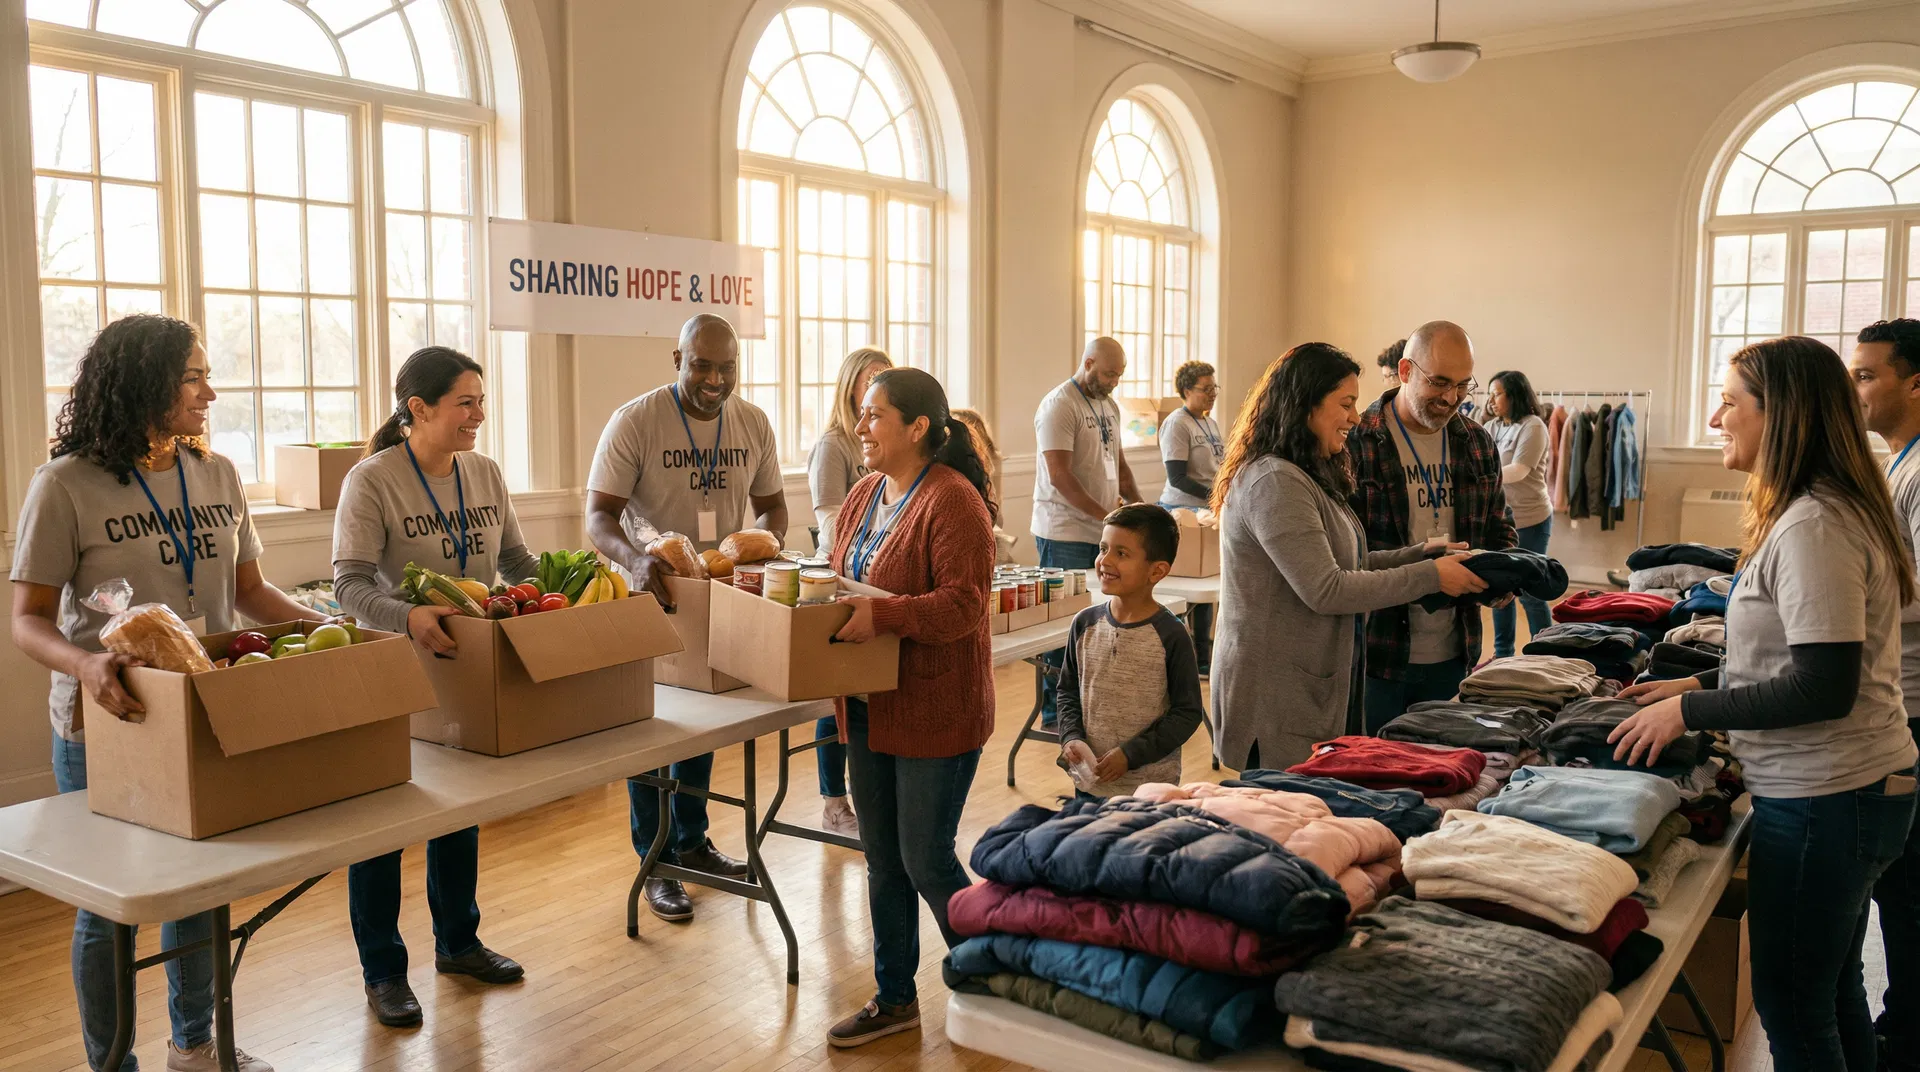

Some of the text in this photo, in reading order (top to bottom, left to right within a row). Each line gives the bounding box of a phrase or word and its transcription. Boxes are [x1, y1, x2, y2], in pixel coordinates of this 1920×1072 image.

[509, 258, 753, 306] SHARING HOPE & LOVE
[662, 448, 749, 469] COMMUNITY
[689, 470, 727, 490] CARE
[104, 504, 239, 543] COMMUNITY
[403, 505, 501, 538] COMMUNITY
